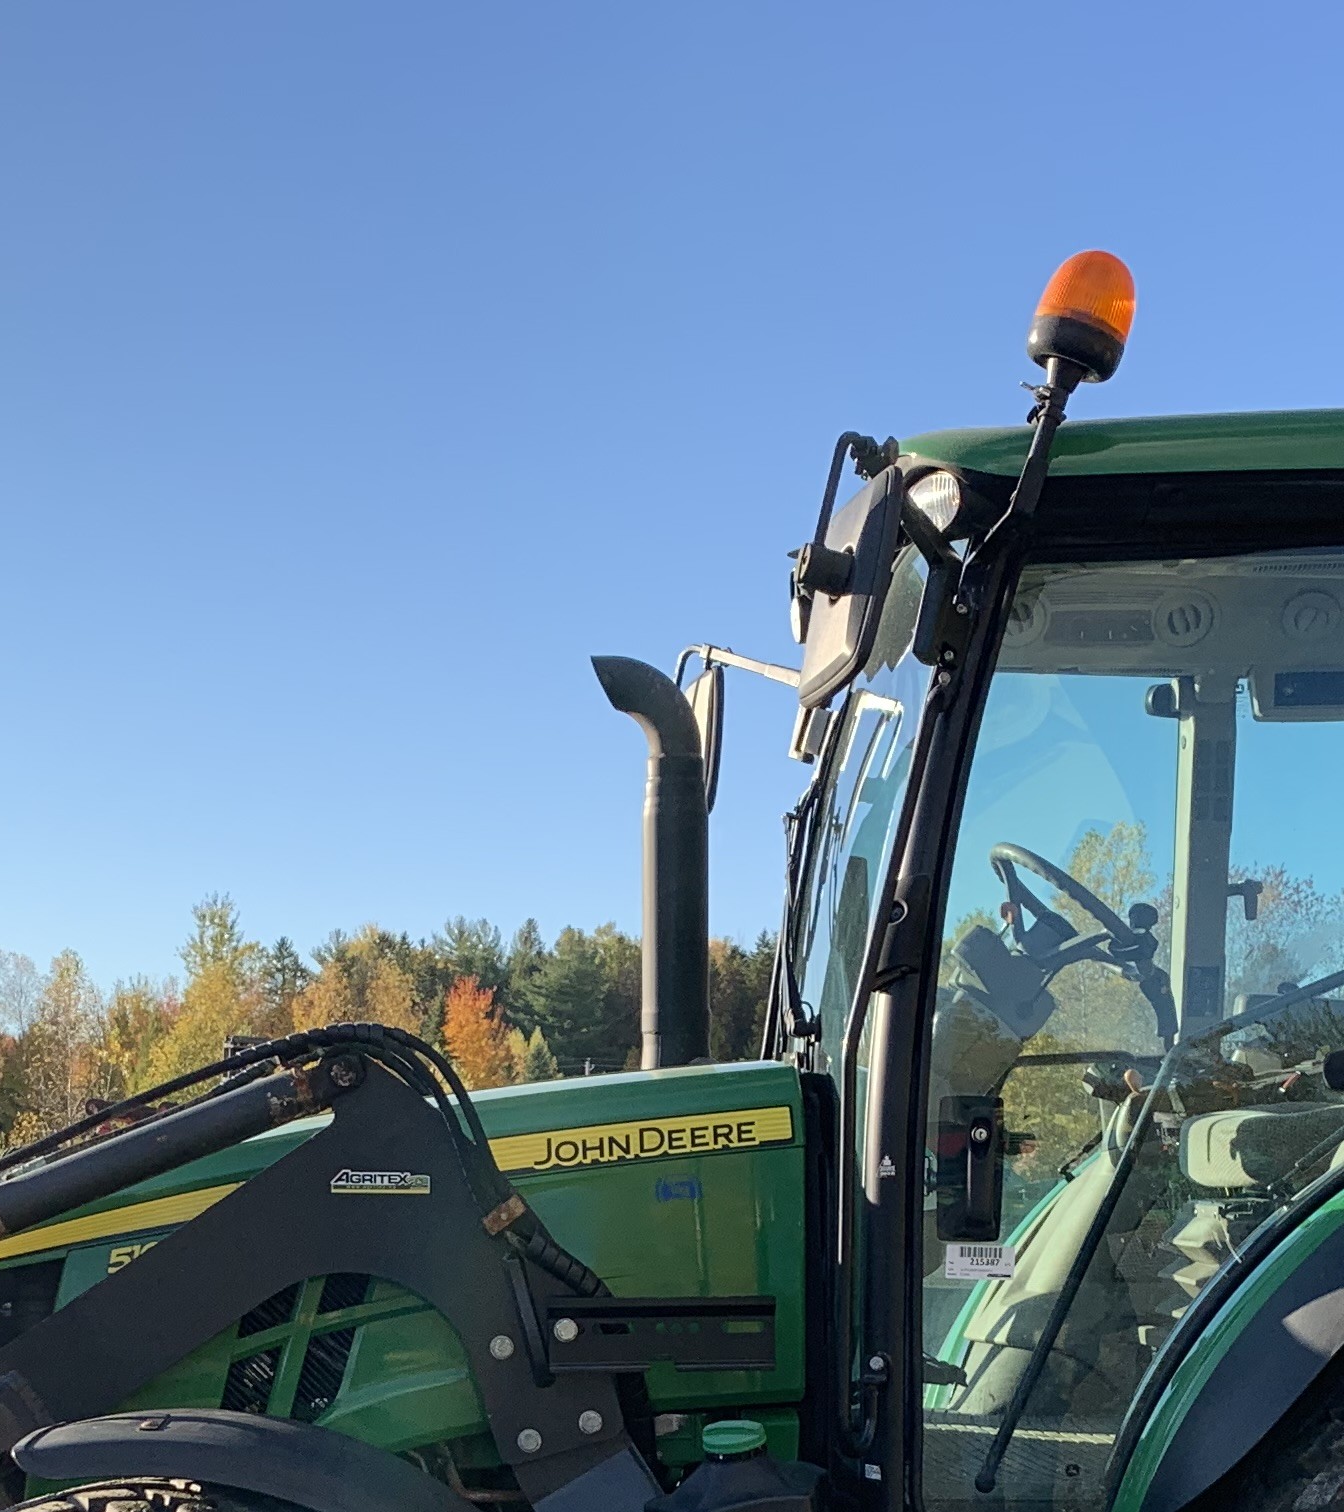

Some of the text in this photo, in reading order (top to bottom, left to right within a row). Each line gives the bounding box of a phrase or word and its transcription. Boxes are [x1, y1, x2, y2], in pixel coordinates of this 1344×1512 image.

[533, 1121, 756, 1166] JOHN DEERE
[333, 1170, 409, 1184] AGRITEX
[969, 1258, 1000, 1266] 215387
